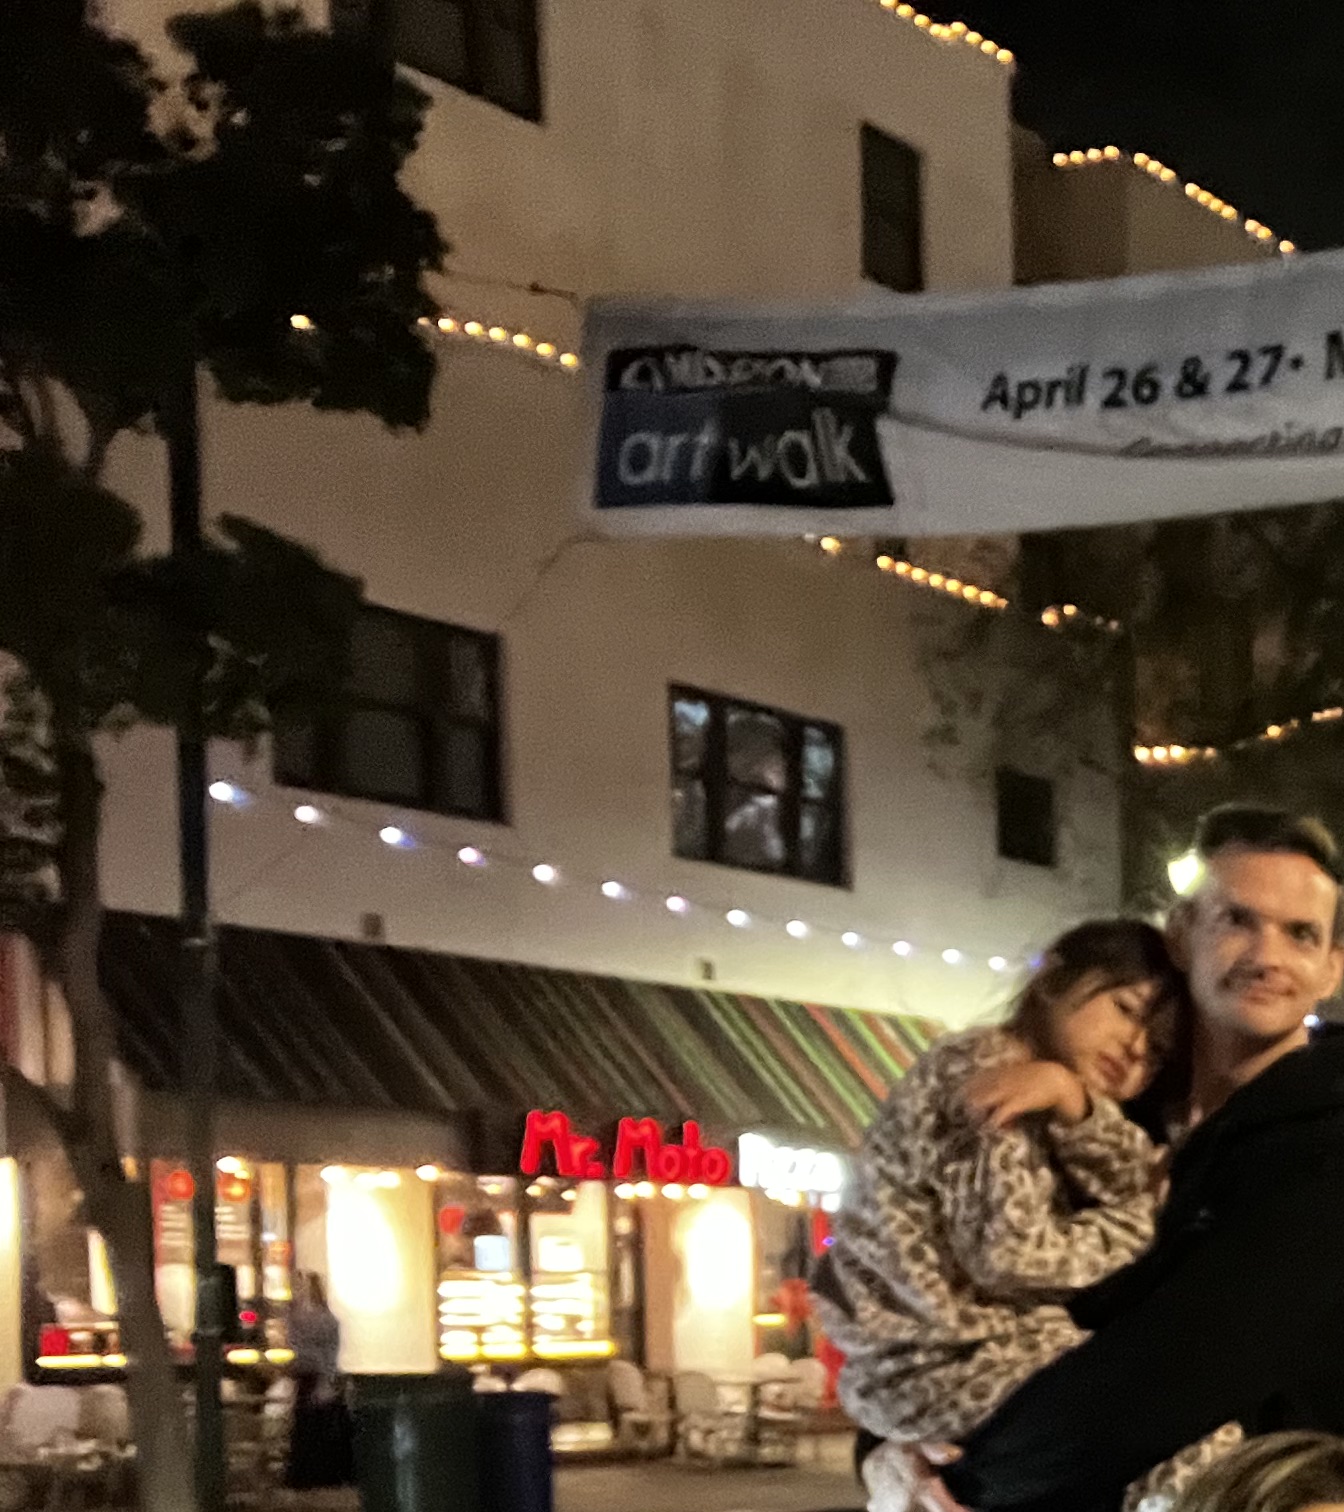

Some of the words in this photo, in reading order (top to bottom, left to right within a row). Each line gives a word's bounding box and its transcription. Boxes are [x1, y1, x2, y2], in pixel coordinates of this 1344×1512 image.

[980, 361, 1091, 420] April
[1101, 363, 1162, 409] 26
[1174, 354, 1211, 400] &
[618, 418, 719, 487] art
[727, 406, 870, 489] walk
